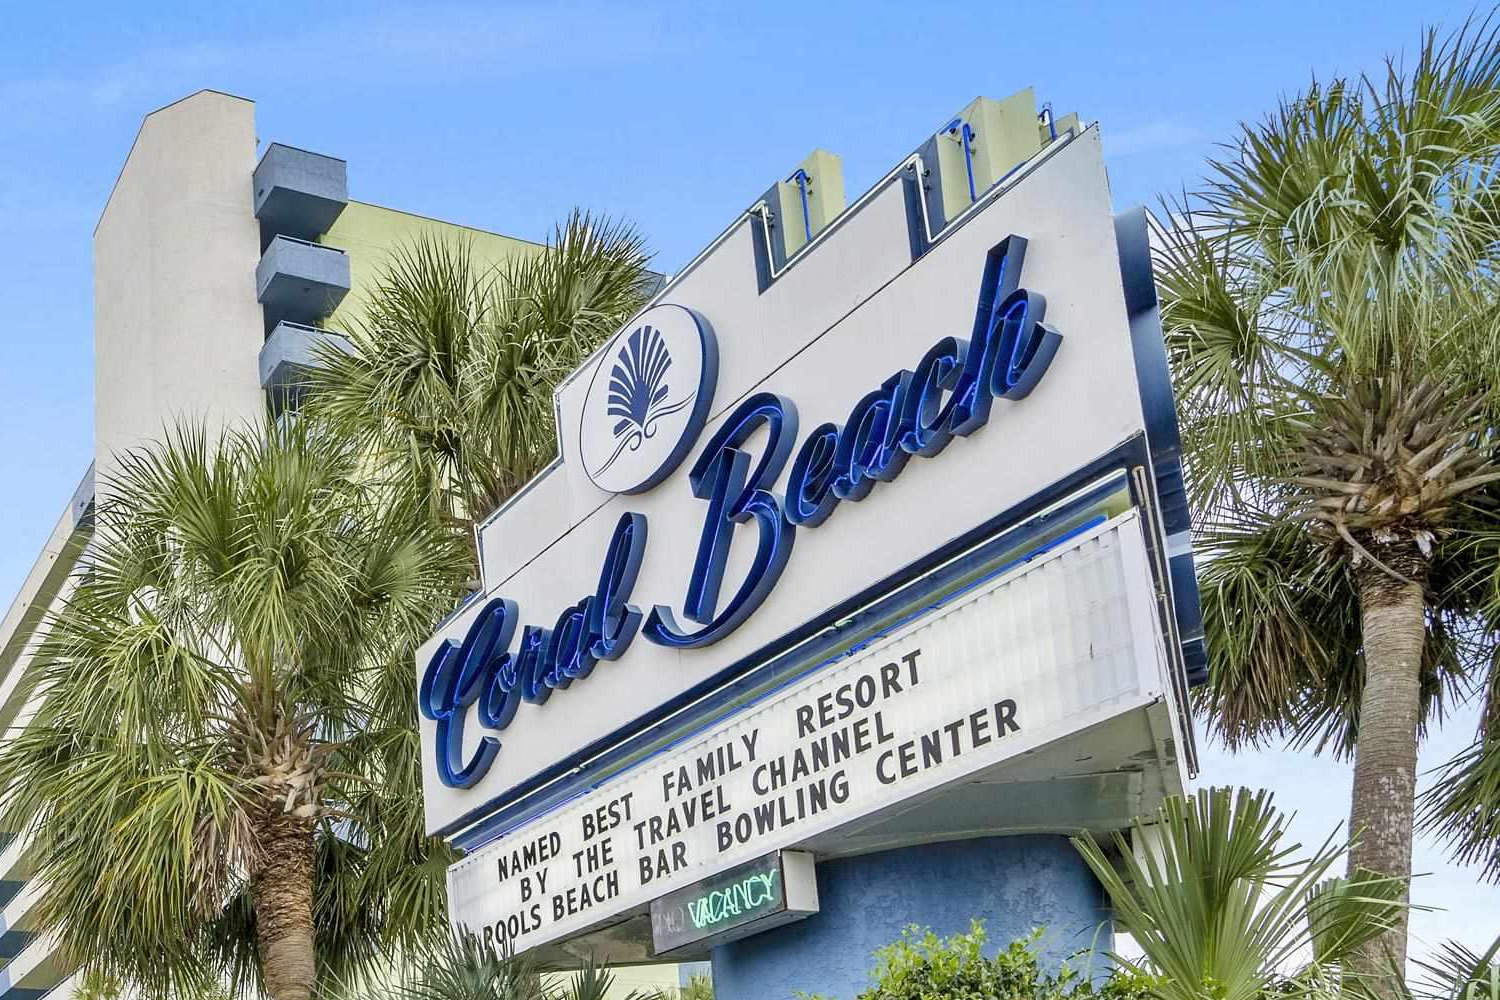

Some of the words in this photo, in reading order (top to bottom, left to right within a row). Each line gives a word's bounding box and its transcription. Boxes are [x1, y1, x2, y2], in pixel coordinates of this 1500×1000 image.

[420, 512, 648, 789] Coral
[641, 234, 1064, 650] Beach
[483, 904, 541, 950] POOLS
[552, 870, 620, 921] BEACH
[639, 841, 688, 886] BAR
[716, 769, 850, 853] BOWLING
[876, 699, 1021, 785] CENTER
[498, 832, 561, 882] NAMED
[582, 792, 634, 842] BEST
[662, 728, 759, 802] FAMILY
[796, 648, 921, 739] RESORT
[520, 868, 549, 903] BY
[573, 838, 614, 878] THE
[633, 785, 731, 850] TRAVEL
[752, 711, 894, 796] CHANNEL
[687, 868, 777, 928] VACANCY
